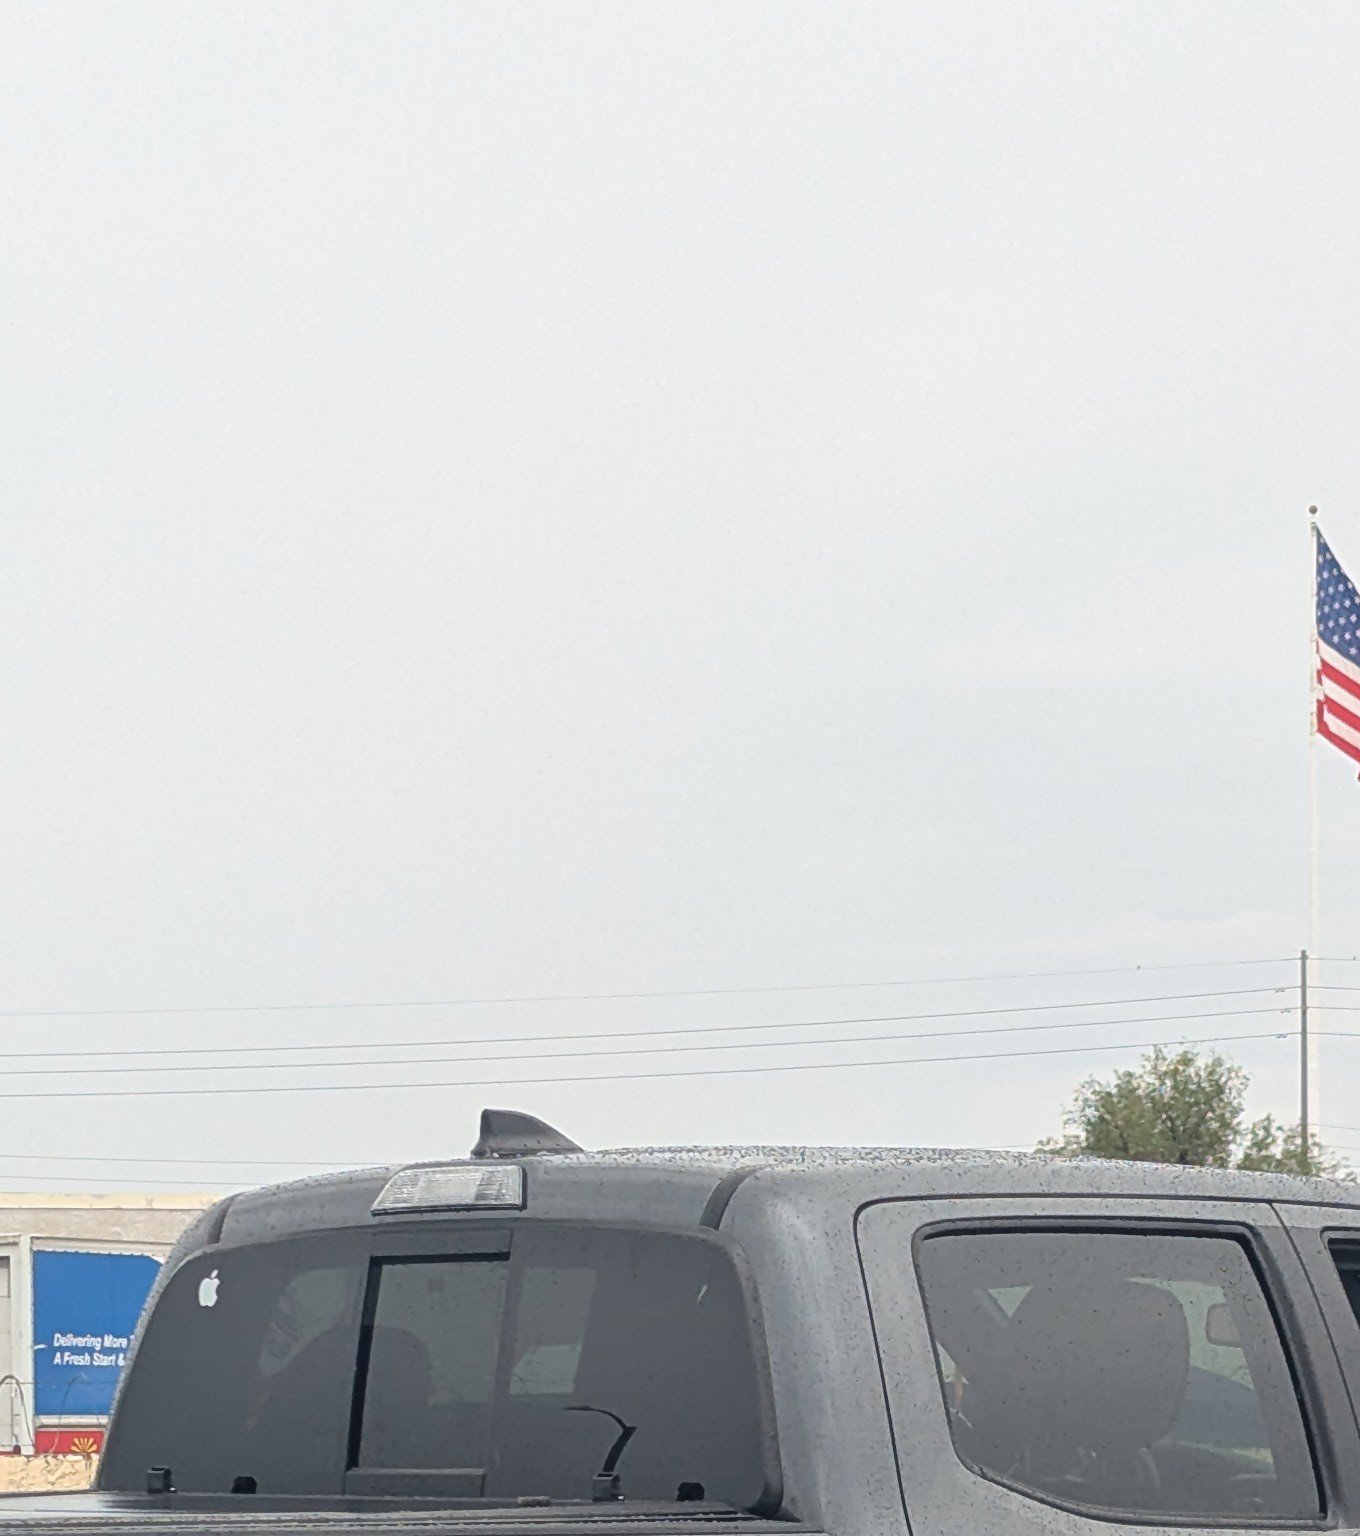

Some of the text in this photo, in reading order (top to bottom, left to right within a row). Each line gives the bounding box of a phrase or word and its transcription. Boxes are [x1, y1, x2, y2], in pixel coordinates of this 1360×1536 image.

[53, 1333, 102, 1350] Delivering
[103, 1334, 128, 1348] More
[53, 1352, 61, 1365] A
[63, 1352, 90, 1365] Fresh
[93, 1352, 116, 1366] Start
